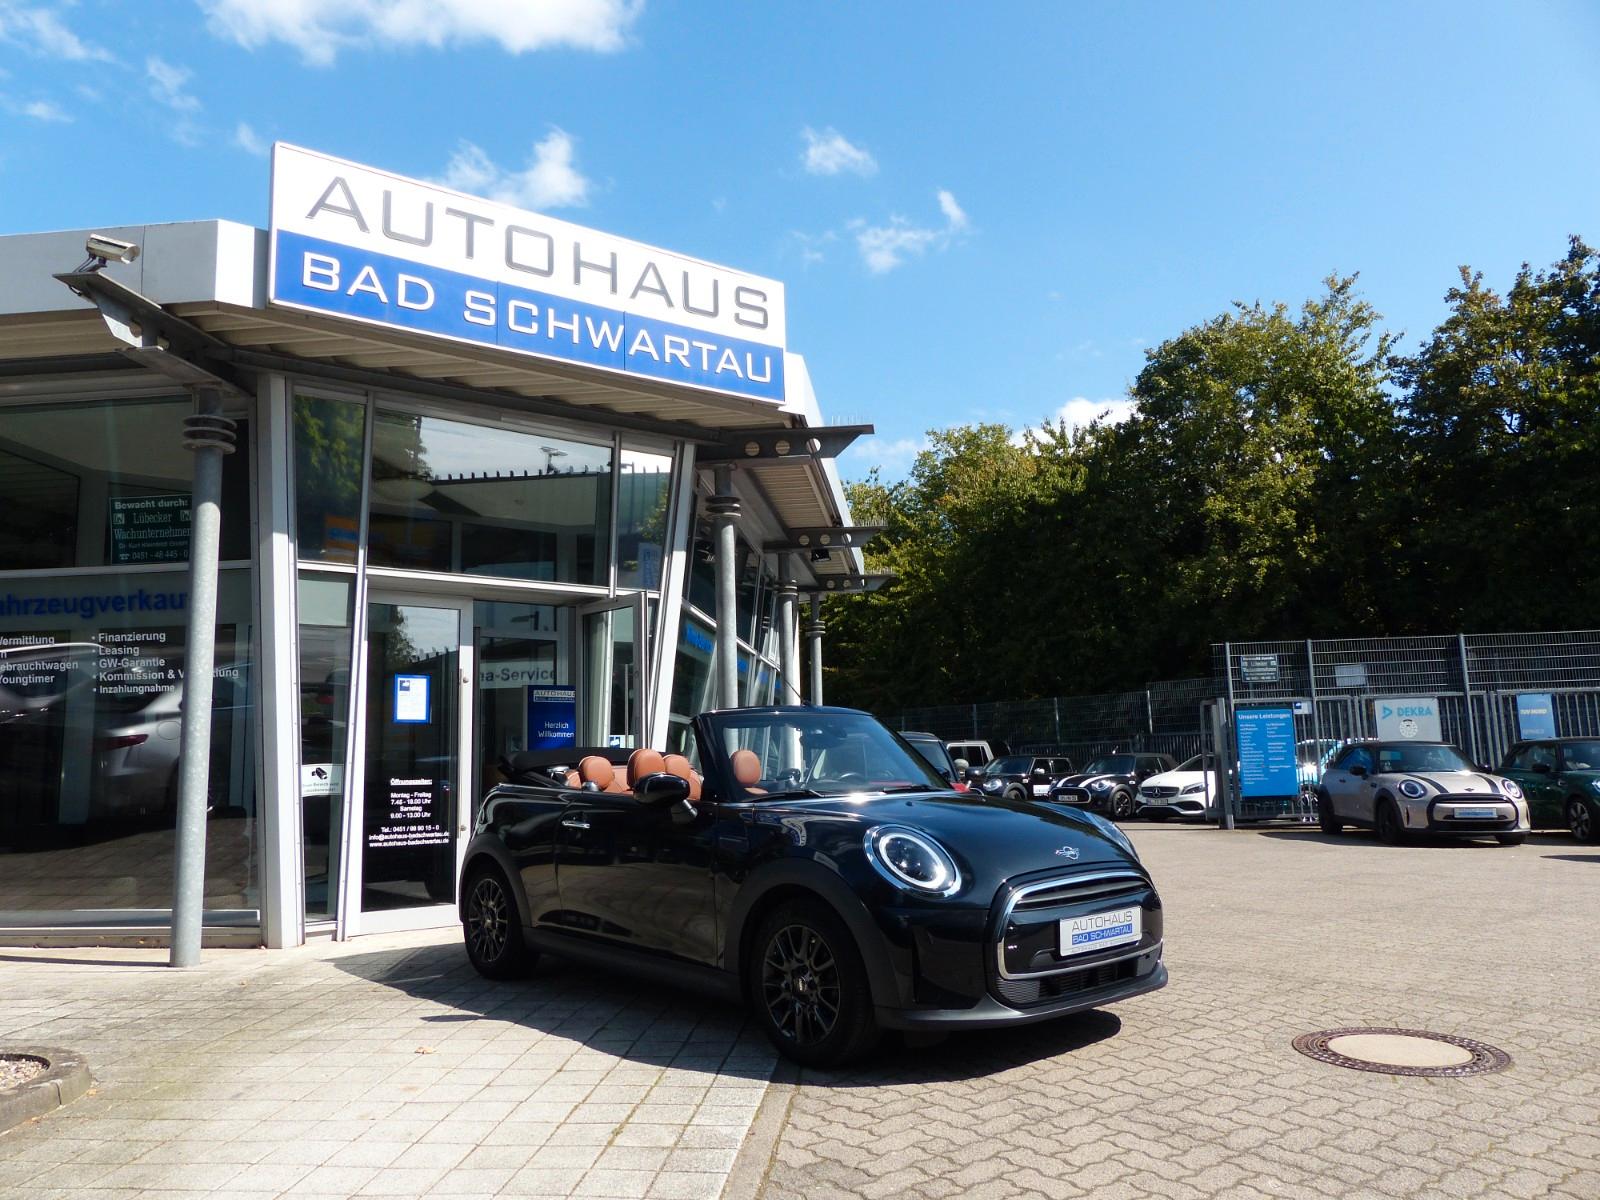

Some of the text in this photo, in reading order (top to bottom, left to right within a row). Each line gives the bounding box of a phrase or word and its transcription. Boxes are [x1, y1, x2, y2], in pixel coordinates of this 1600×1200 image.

[305, 176, 769, 331] AUTOHAUS
[302, 251, 771, 383] BAD SCHWARTAU
[114, 498, 188, 510] Bewacht durch:
[133, 511, 172, 524] Lübecker
[0, 588, 188, 619] hrzeugverkau
[98, 631, 166, 643] Finanzierung
[99, 645, 140, 656] Leasing
[99, 657, 166, 668] GW-Garantie
[99, 670, 165, 682] Kommission
[167, 669, 176, 680] &
[99, 683, 175, 695] Inzahlungnahme
[1397, 706, 1433, 717] DEKRA
[544, 721, 569, 729] Herzlich
[537, 730, 575, 738] Willkommen
[1072, 911, 1133, 932] AUTOHAUS
[1072, 925, 1132, 943] BAD SCHWARTAU
